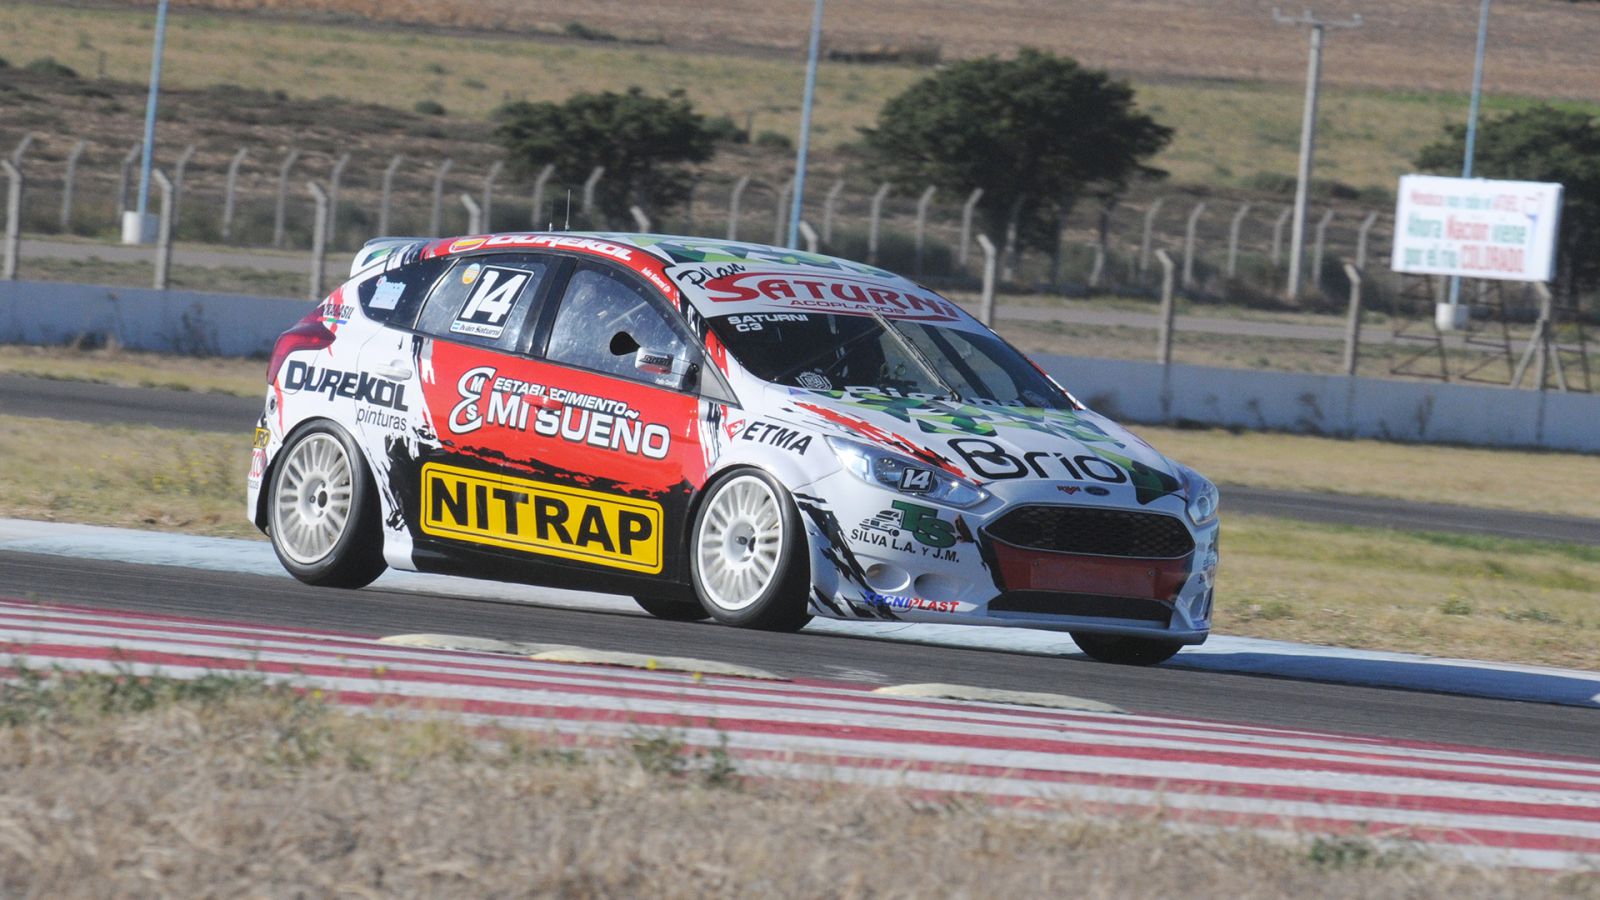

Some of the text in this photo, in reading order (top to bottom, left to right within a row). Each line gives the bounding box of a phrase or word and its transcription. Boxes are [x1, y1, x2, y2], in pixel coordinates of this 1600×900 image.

[486, 235, 633, 261] DUREKOL
[1404, 247, 1422, 271] por
[1461, 245, 1524, 273] COLORADO
[676, 262, 746, 290] Plan
[461, 270, 527, 323] 14
[790, 300, 906, 315] ACOPLADOS
[727, 314, 809, 326] SATURNI
[737, 323, 764, 333] C3
[285, 360, 409, 412] DUREKOL
[494, 377, 627, 413] ESTABLECIMIENTO
[356, 406, 407, 432] pinturas
[487, 392, 671, 459] MI SUEÑO
[742, 421, 813, 456] ETMA
[947, 438, 1127, 484] Brio
[902, 469, 931, 489] 14
[431, 477, 653, 556] NITRAP
[892, 500, 956, 548] TS
[851, 529, 887, 548] SILVA
[892, 539, 916, 554] L.A.
[933, 548, 960, 563] J.M.
[864, 591, 960, 613] TECNIPLAST
